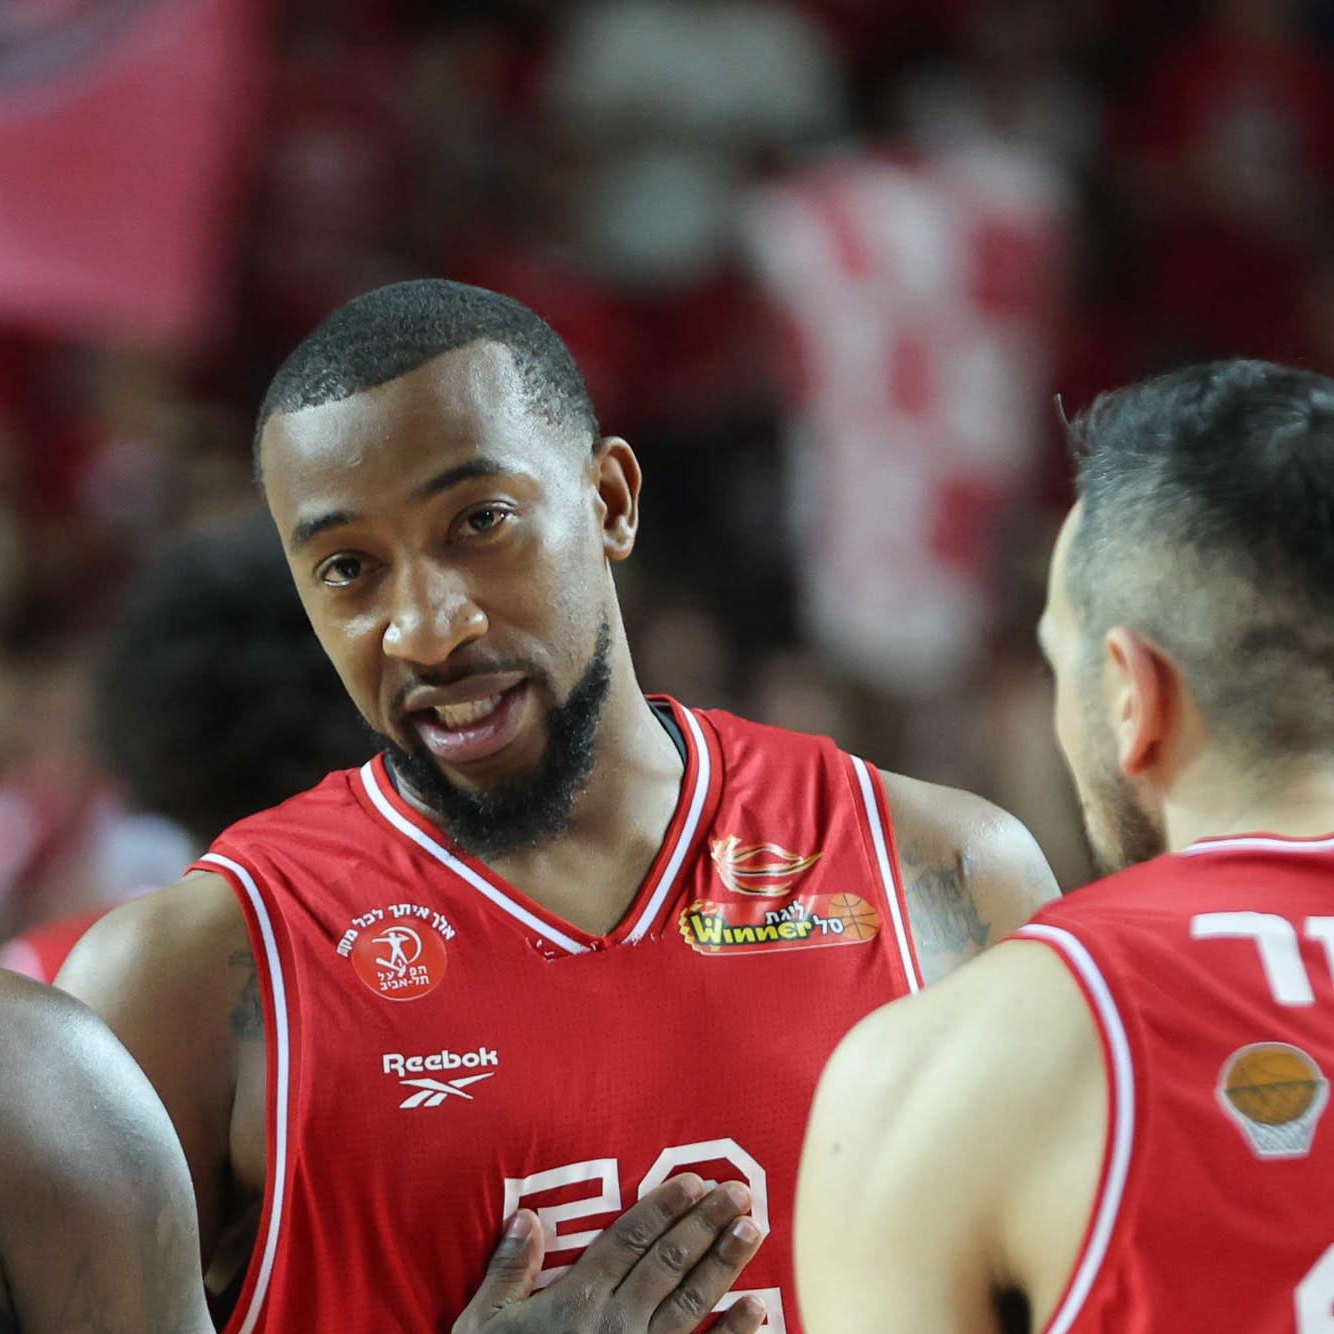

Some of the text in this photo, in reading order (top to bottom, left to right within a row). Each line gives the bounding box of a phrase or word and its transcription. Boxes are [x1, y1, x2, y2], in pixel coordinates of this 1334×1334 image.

[351, 908, 384, 928] לכל
[388, 903, 430, 919] איתך
[765, 900, 806, 926] ליגת
[432, 911, 456, 941] אלך
[813, 915, 845, 936] סל
[382, 1046, 499, 1077] Reebok
